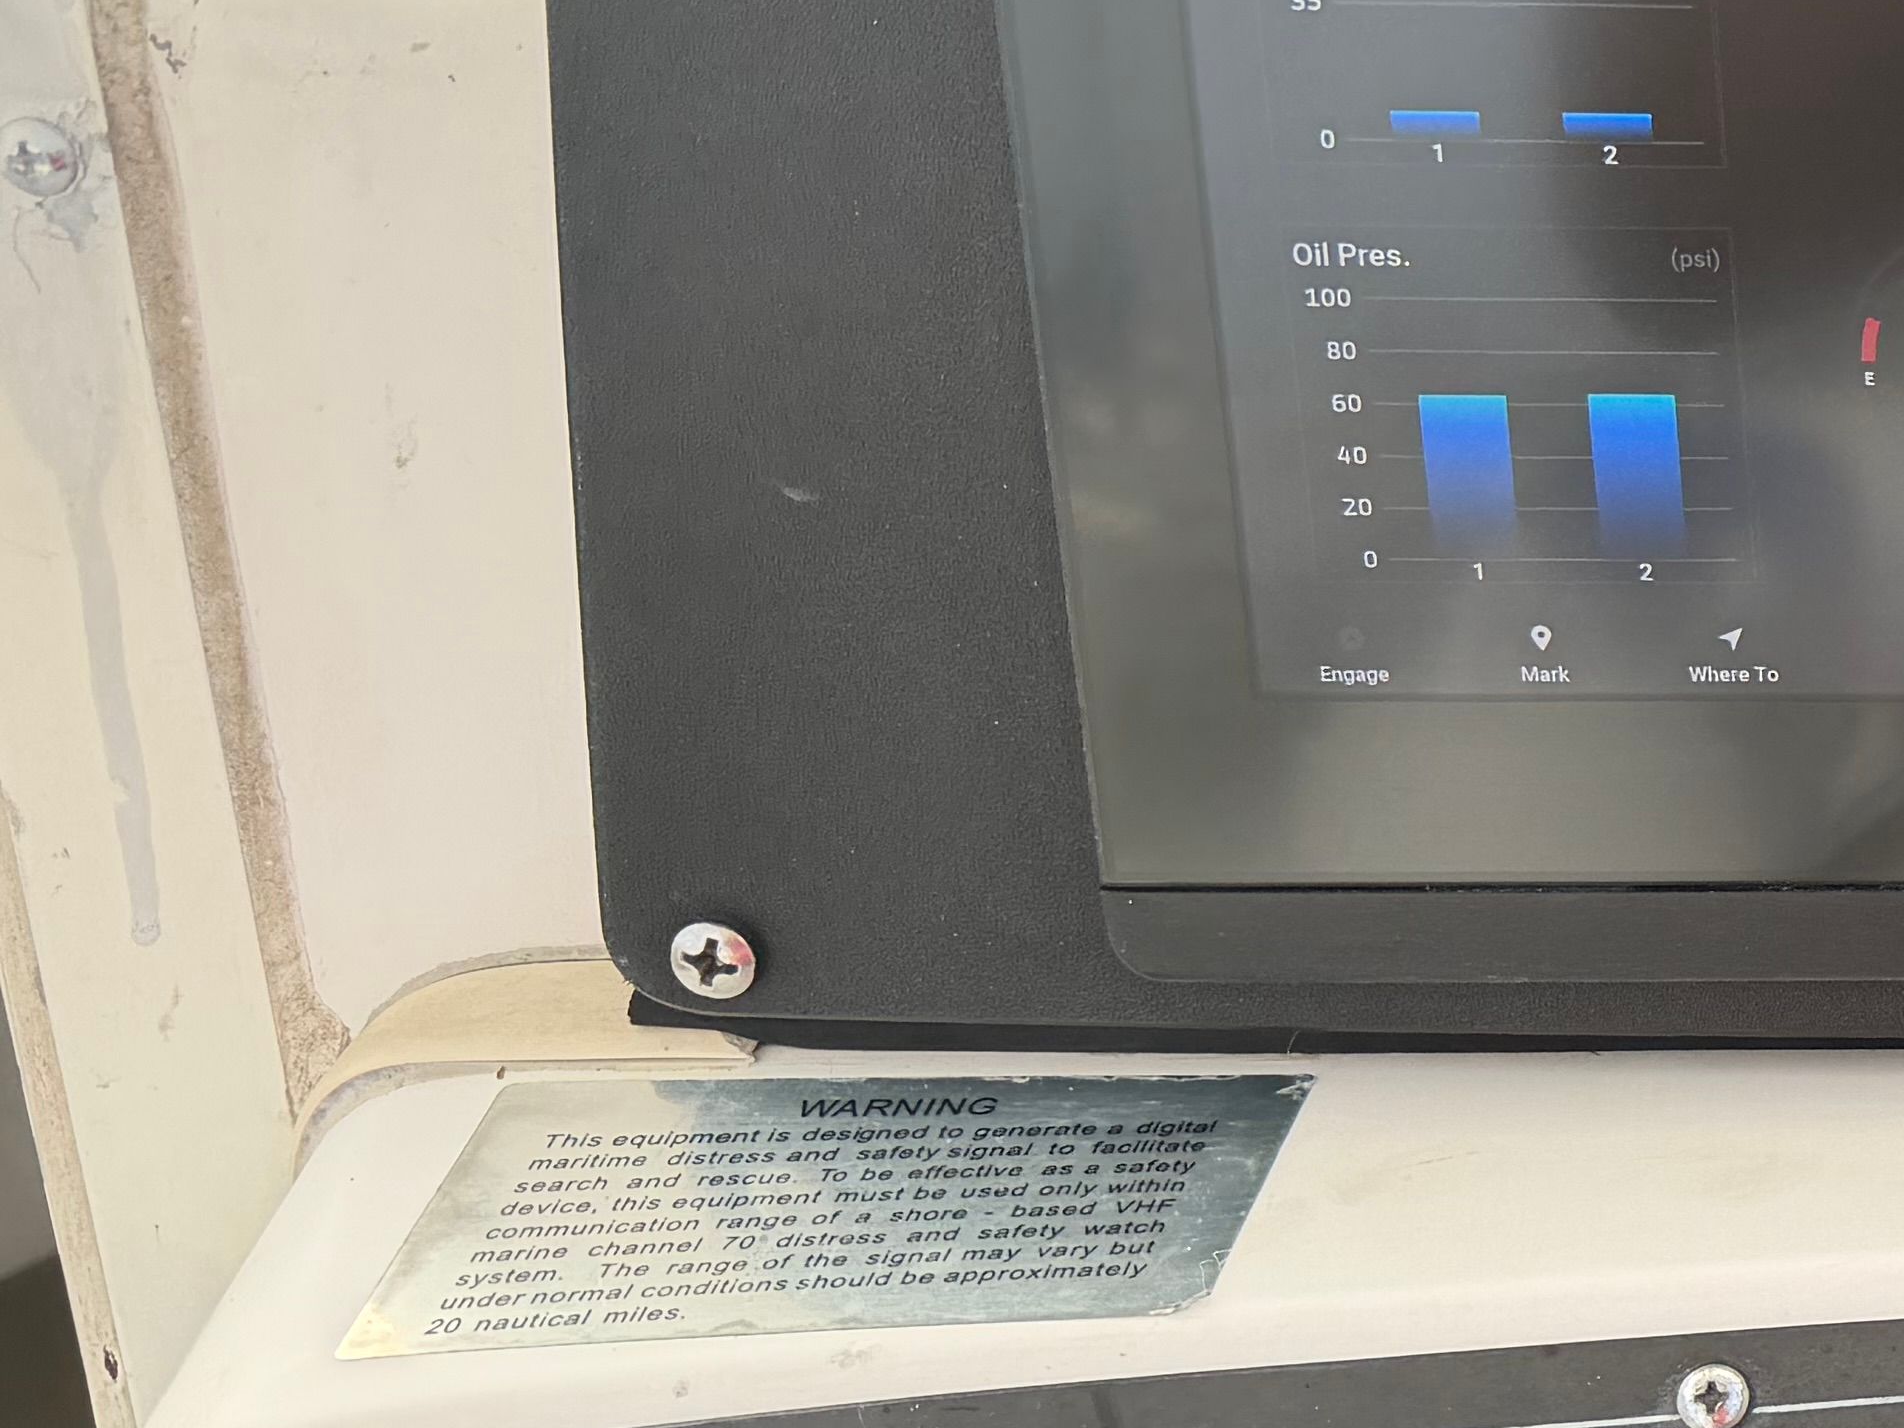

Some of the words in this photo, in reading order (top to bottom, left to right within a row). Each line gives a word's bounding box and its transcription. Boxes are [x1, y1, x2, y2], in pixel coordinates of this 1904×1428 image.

[1293, 244, 1329, 267] Oil
[1338, 245, 1411, 267] Pres.
[1671, 247, 1720, 273] (psi)
[1305, 288, 1351, 307] 100
[1332, 395, 1362, 413] 60
[1337, 447, 1367, 465] 40
[1342, 499, 1372, 517] 20
[1320, 666, 1389, 686] Engage
[1522, 667, 1570, 683] Mark
[1689, 666, 1749, 683] Where
[1754, 666, 1779, 683] To
[801, 1097, 999, 1118] WARNING
[546, 1133, 601, 1148] This
[613, 1130, 760, 1149] equipment
[767, 1129, 791, 1143] is
[802, 1125, 930, 1145] designed
[938, 1125, 964, 1139] to
[972, 1122, 1096, 1142] generate
[1107, 1124, 1124, 1135] a
[1137, 1120, 1218, 1137] digital
[528, 1155, 647, 1171] maritime
[668, 1149, 776, 1166] distress
[786, 1148, 839, 1163] and
[856, 1144, 940, 1162] safety
[947, 1144, 1033, 1161] signal
[1049, 1141, 1075, 1155] to
[1092, 1139, 1206, 1154] facilitate
[500, 1199, 597, 1217] device,
[612, 1195, 659, 1212] this
[672, 1191, 822, 1211] equipment
[835, 1187, 905, 1202] must
[913, 1186, 947, 1201] be
[960, 1182, 1029, 1199] used
[1039, 1180, 1097, 1199] only
[1108, 1179, 1185, 1193] within
[470, 1245, 568, 1264] marine
[588, 1238, 703, 1258] channel
[722, 1235, 756, 1250] 70
[776, 1231, 887, 1248] distress
[907, 1227, 960, 1242] and
[978, 1223, 1065, 1242] safety
[1084, 1220, 1165, 1235] watch
[440, 1292, 526, 1311] under
[530, 1286, 631, 1305] normal
[641, 1278, 787, 1299] conditions
[795, 1271, 891, 1291] should
[901, 1271, 934, 1286] be
[944, 1262, 1147, 1285] approximately
[424, 1318, 461, 1335] 20
[474, 1310, 591, 1333] nautical
[603, 1306, 686, 1324] miles.
